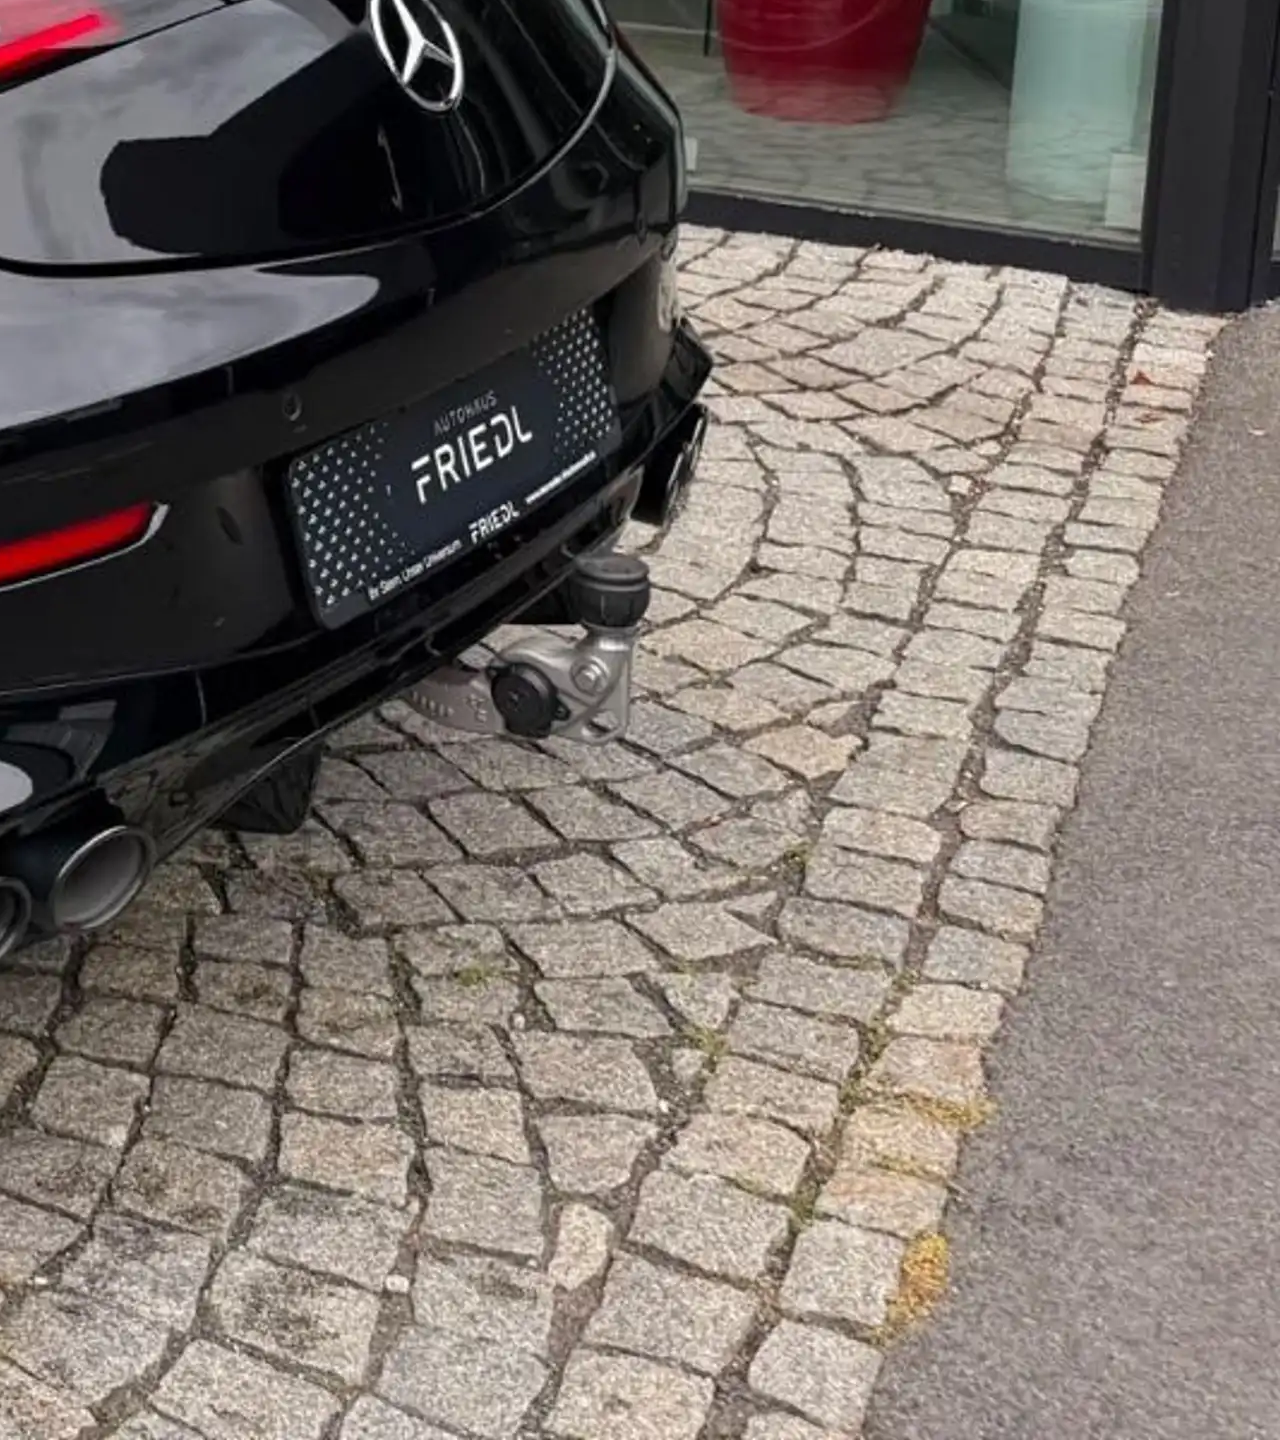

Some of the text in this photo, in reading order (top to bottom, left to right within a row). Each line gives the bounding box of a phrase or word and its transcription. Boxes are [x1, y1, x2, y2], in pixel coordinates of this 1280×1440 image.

[434, 389, 498, 437] AUTOHAUS
[411, 405, 533, 505] FRIEDL
[468, 500, 521, 545] FRIEDL
